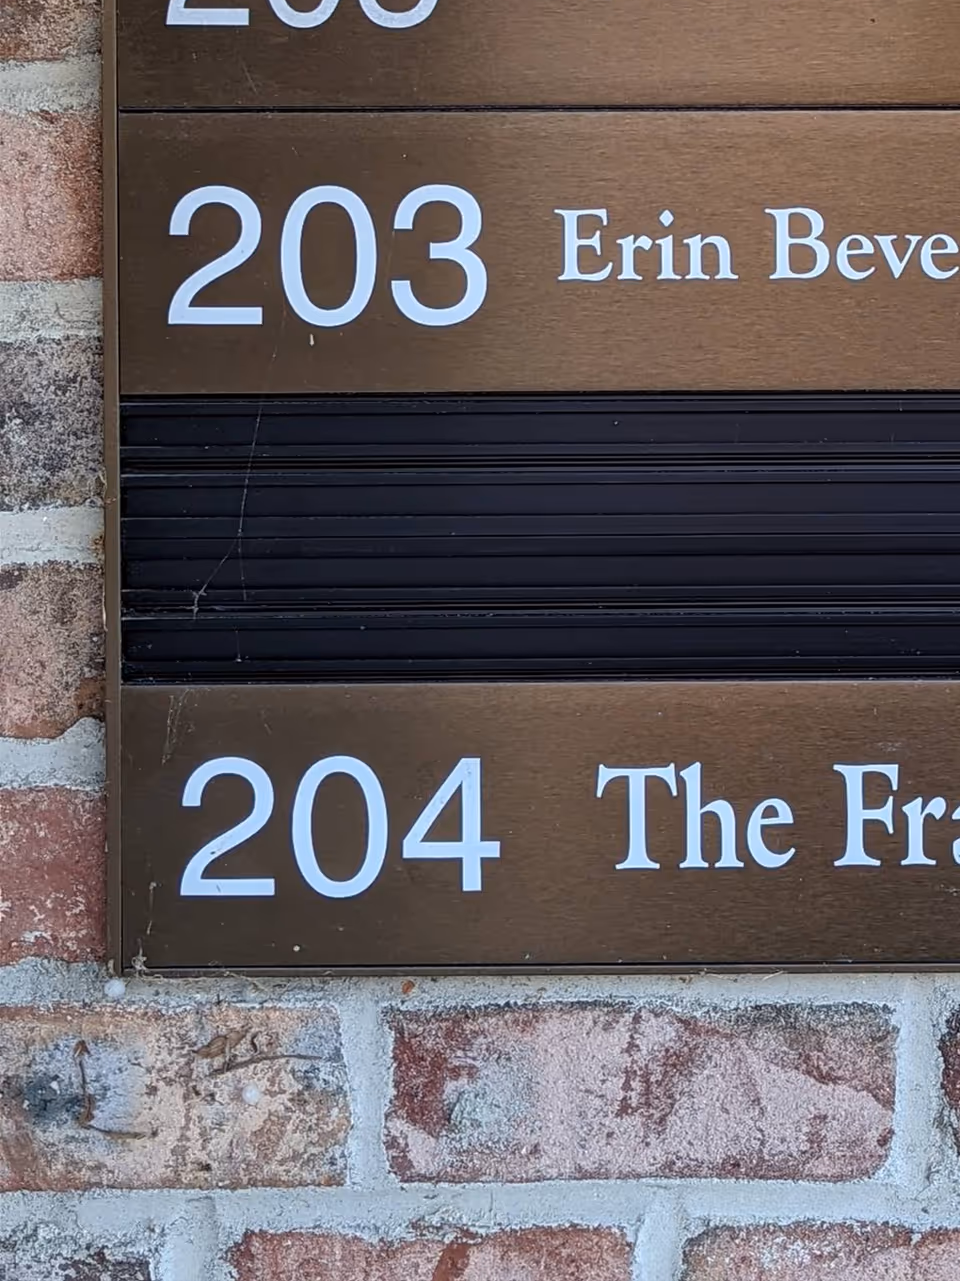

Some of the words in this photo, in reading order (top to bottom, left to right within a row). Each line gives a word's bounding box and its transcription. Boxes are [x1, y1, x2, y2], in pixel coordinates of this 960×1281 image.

[167, 184, 488, 327] 203
[554, 207, 738, 282] Erin
[180, 755, 501, 898] 204
[596, 761, 796, 870] The
